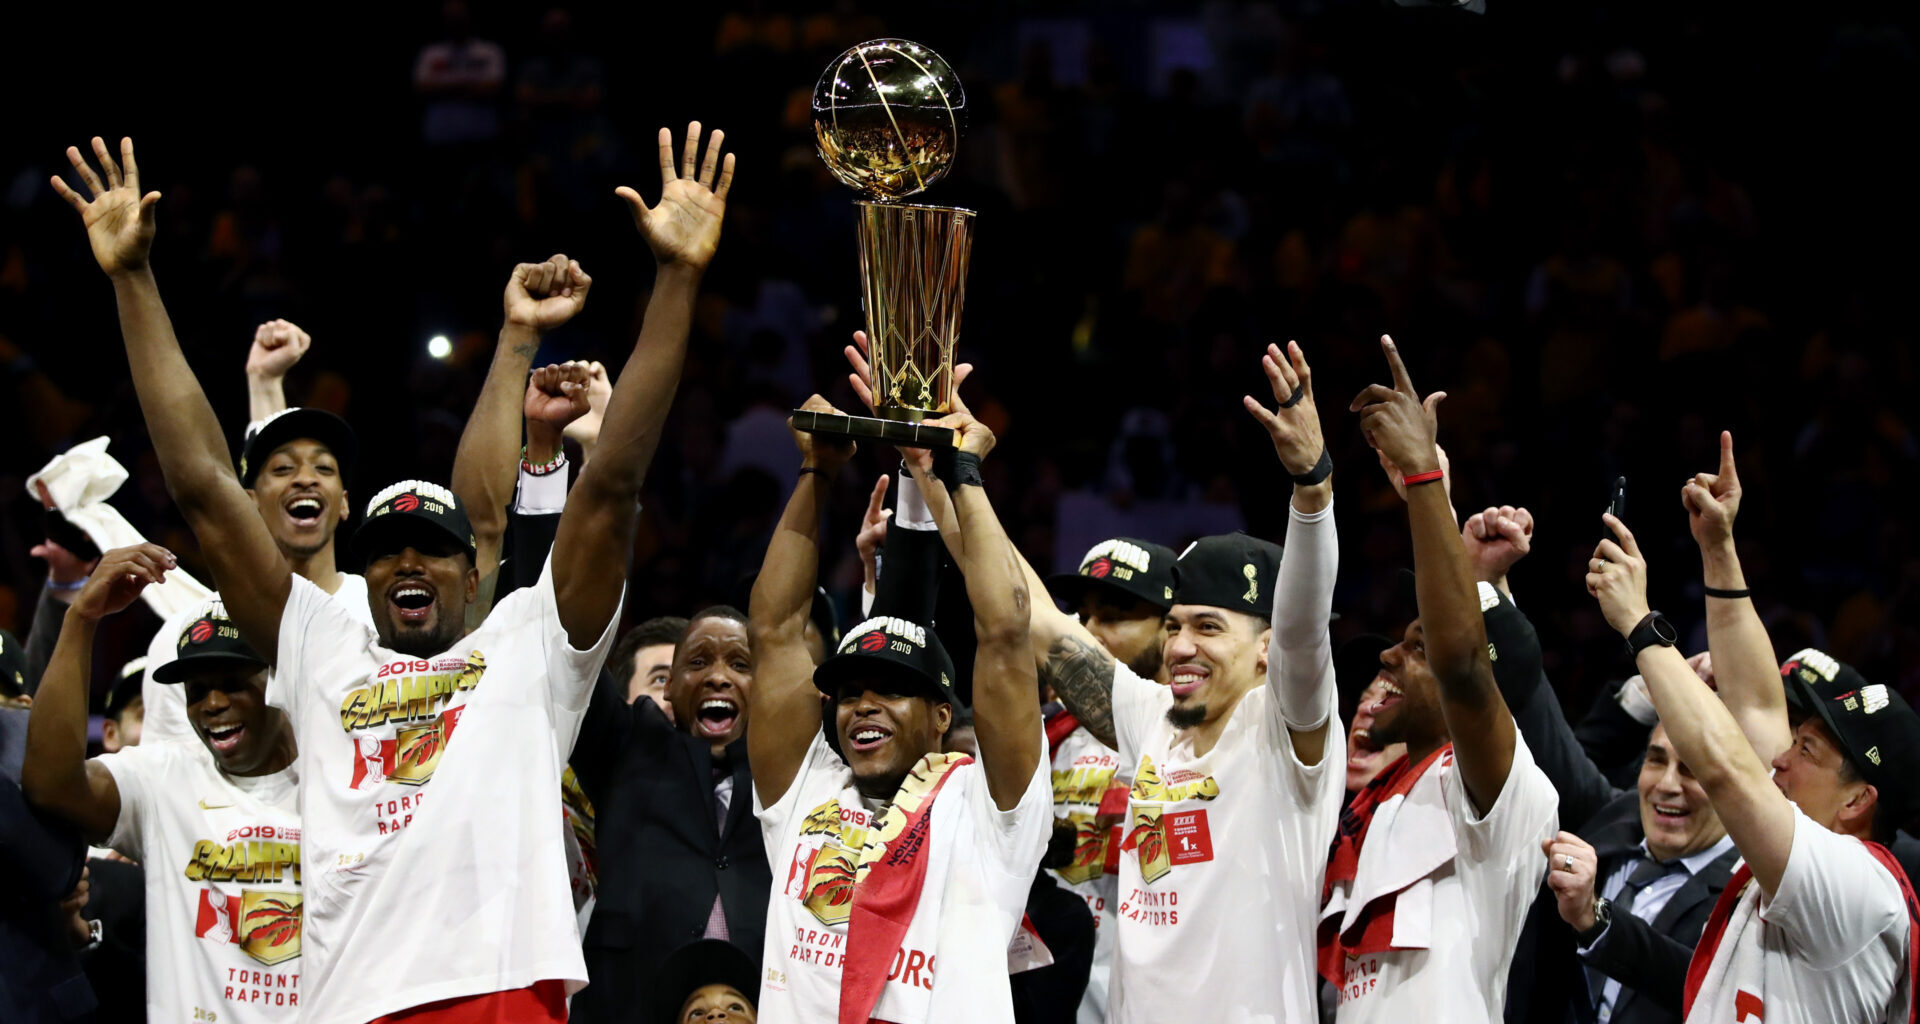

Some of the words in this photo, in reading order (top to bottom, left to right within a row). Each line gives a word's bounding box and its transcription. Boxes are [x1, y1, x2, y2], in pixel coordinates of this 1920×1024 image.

[424, 501, 444, 515] 2019
[218, 625, 239, 639] 2019
[891, 640, 912, 655] 2019
[377, 660, 430, 678] 2019
[839, 807, 866, 826] 019
[227, 826, 275, 842] 2019
[185, 840, 302, 885] CHAMPI
[790, 945, 847, 969] RAPTOR
[228, 968, 299, 988] TORONT
[225, 986, 298, 1006] RAPTOR
